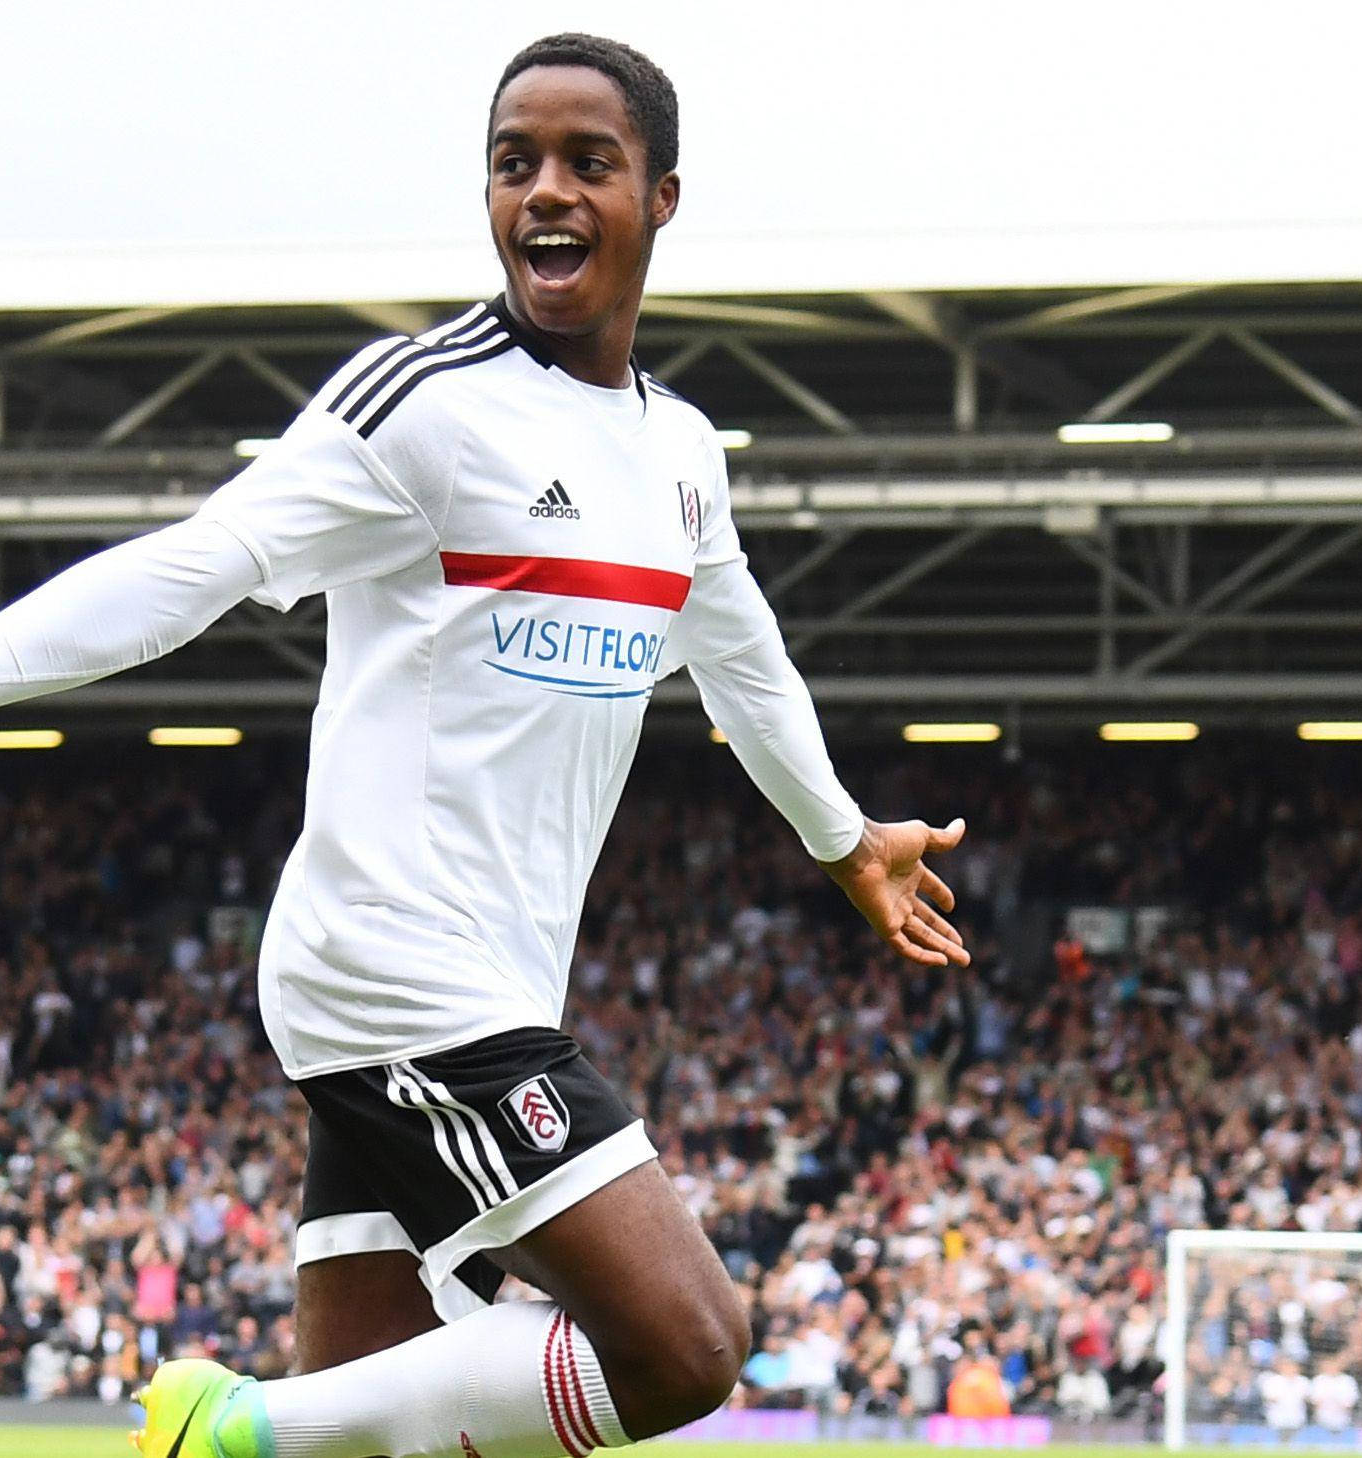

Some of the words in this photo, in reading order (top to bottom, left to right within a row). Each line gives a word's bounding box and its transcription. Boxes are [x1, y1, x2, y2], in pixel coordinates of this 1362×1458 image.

[529, 504, 580, 520] adidas
[492, 612, 667, 673] VISITFLORI
[522, 1091, 557, 1139] FFC
